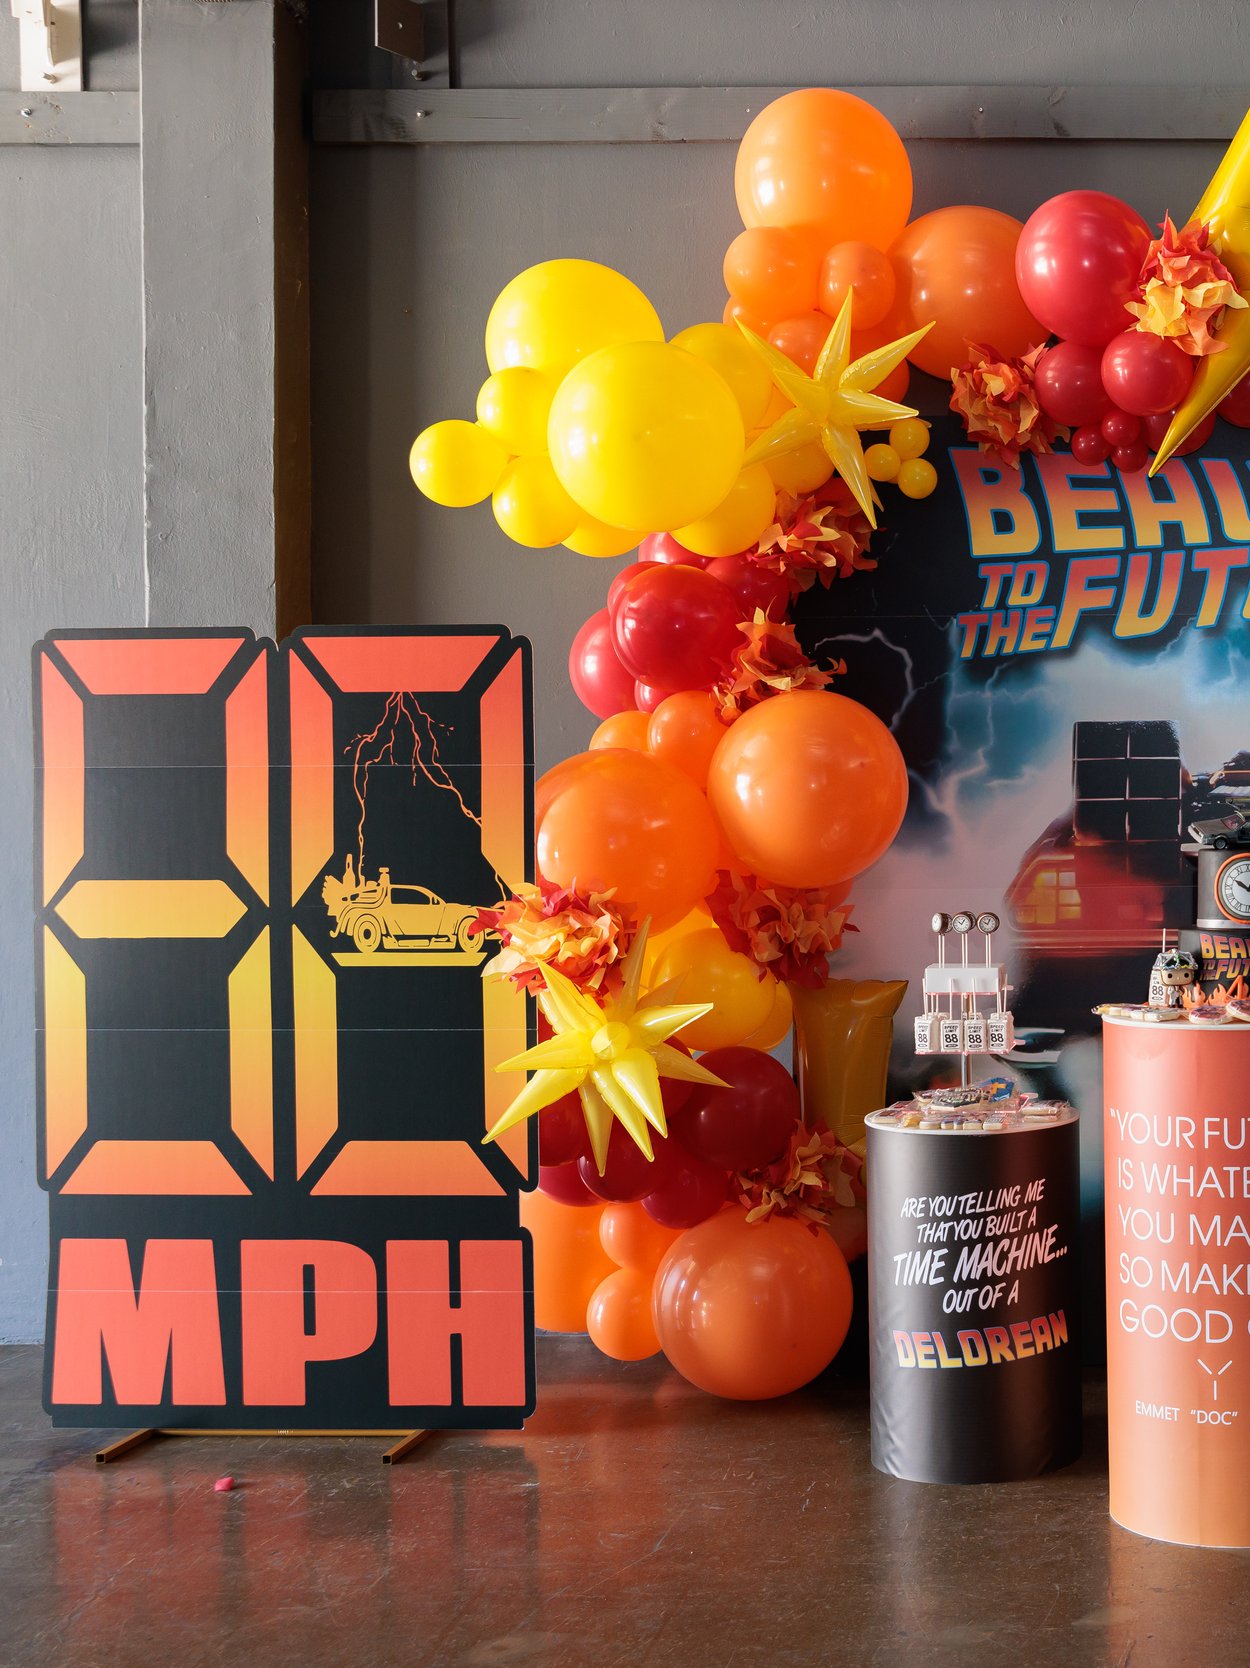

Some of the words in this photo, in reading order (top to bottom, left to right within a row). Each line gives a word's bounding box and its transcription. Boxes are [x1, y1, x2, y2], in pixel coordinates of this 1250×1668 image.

[978, 561, 1050, 609] TO
[957, 607, 1057, 660] THE
[1152, 985, 1164, 996] 88
[918, 1033, 928, 1043] 88
[945, 1033, 959, 1043] 88
[968, 1034, 982, 1044] 88
[990, 1033, 1004, 1043] 88
[1110, 1108, 1196, 1149] "YOUR
[1117, 1156, 1134, 1191] IS
[900, 1196, 927, 1219] ARE
[927, 1193, 958, 1218] YOU
[958, 1185, 1021, 1215] TELLING
[1024, 1178, 1046, 1202] ME
[916, 1221, 954, 1244] THAT
[953, 1217, 983, 1241] YOU
[985, 1212, 1025, 1237] BUILT
[1027, 1206, 1037, 1227] A
[1117, 1204, 1175, 1244] YOU
[893, 1248, 949, 1286] TIME
[953, 1224, 1068, 1285] MACHINE...
[1119, 1252, 1154, 1289] SO
[942, 1287, 979, 1314] OUT
[978, 1282, 1006, 1310] OF
[1006, 1279, 1019, 1305] A
[51, 1238, 527, 1407] MPH
[892, 1309, 1069, 1370] DELOREAN
[1119, 1298, 1234, 1344] GOOD
[1135, 1400, 1180, 1422] EMMET
[1190, 1408, 1239, 1426] "DOC"
